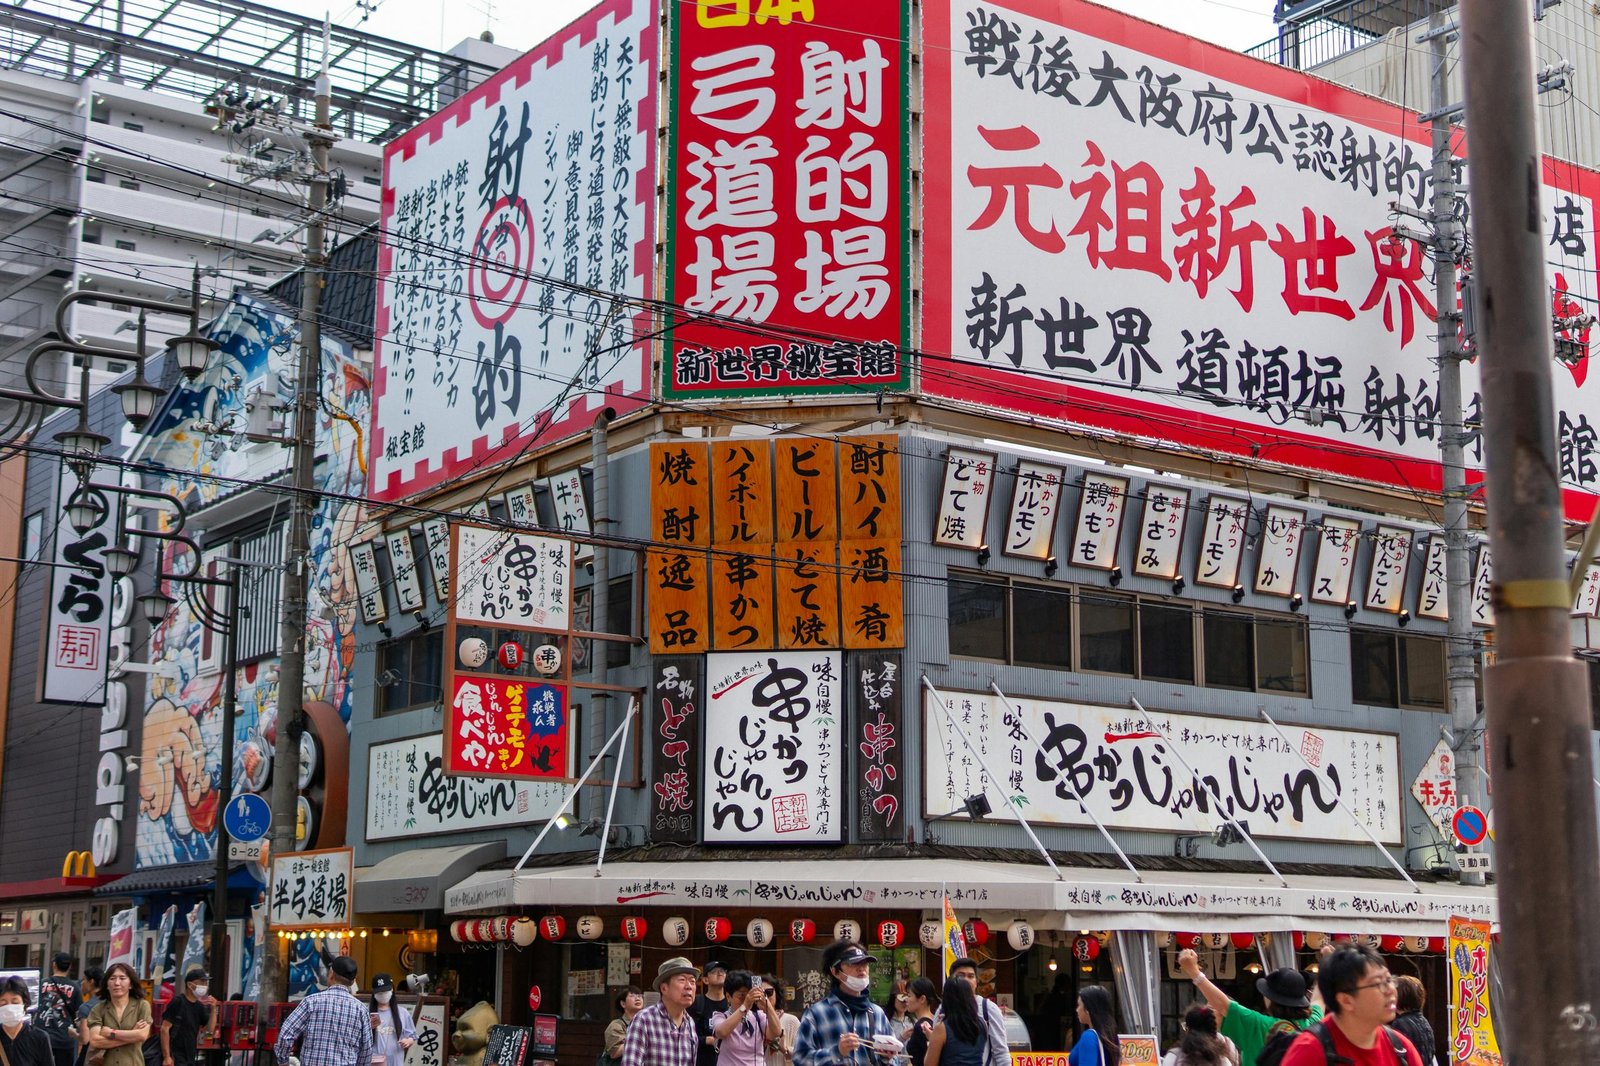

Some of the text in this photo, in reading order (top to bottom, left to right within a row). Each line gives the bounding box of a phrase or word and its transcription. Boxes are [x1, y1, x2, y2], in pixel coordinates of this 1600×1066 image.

[607, 37, 632, 358] 天下無敵の大阪新世界
[684, 44, 780, 324] 弓道場
[793, 40, 890, 321] 射的場
[678, 344, 898, 384] 新世界秘宝館
[964, 270, 1164, 394] 新世界
[1177, 328, 1348, 434] 道頓堀
[384, 422, 426, 462] 秘宝館
[570, 476, 585, 518] 串かつ
[660, 448, 700, 543] 焼酎
[724, 446, 760, 543] ハイボール
[790, 443, 825, 541] ビール
[850, 441, 889, 518] 酎ハイ
[942, 460, 973, 542] どて焼
[971, 461, 988, 496] 名物
[1012, 471, 1042, 550] ホルモン
[1040, 473, 1057, 517] 串かつ
[1104, 485, 1121, 528] 串かつ
[1081, 482, 1110, 561] 鶏もも
[1140, 492, 1170, 568] ささみ
[1166, 496, 1183, 539] 串かつ
[1203, 504, 1231, 579] サーモン
[1227, 507, 1242, 549] 串かつ
[1261, 514, 1287, 587] いか
[1285, 516, 1298, 558] 串かつ
[1340, 527, 1354, 567] 串かつ
[390, 538, 414, 606] ほたて
[480, 572, 505, 620] じゃん
[497, 565, 514, 611] じゃん
[504, 537, 539, 618] 串かつ
[548, 544, 568, 606] 味自慢
[657, 550, 700, 649] 逸品
[724, 552, 760, 649] 串かつ
[790, 548, 830, 648] どて焼
[850, 546, 892, 643] 酒肴
[1370, 533, 1396, 605] れんこん
[59, 628, 97, 666] 寿司
[541, 647, 558, 671] 串かつ
[656, 665, 696, 700] 名物
[879, 661, 897, 698] 屋台
[751, 657, 812, 785] 串かつ
[811, 656, 839, 716] 味自慢
[861, 668, 882, 711] 仕込み
[961, 699, 972, 724] 海老
[506, 684, 526, 768] ゲテモノ
[654, 697, 695, 812] どて焼
[739, 715, 773, 801] じゃん
[979, 702, 989, 756] じゃがいも
[1002, 704, 1029, 794] 味自慢
[405, 743, 418, 816] 味自慢
[712, 745, 765, 833] じゃん
[859, 712, 899, 828] 串かつ
[1419, 779, 1458, 807] キンチョ
[272, 871, 349, 920] 半弓道場
[684, 882, 730, 900] 味自慢
[754, 882, 864, 902] 串かつじゃんじゃん
[1067, 887, 1102, 905] 味自慢
[1458, 857, 1491, 869] 自動車
[1307, 895, 1337, 912] 味自慢
[1453, 978, 1474, 1060] ドッグ
[1471, 945, 1488, 1028] ホット
[1126, 1041, 1154, 1062] Dog
